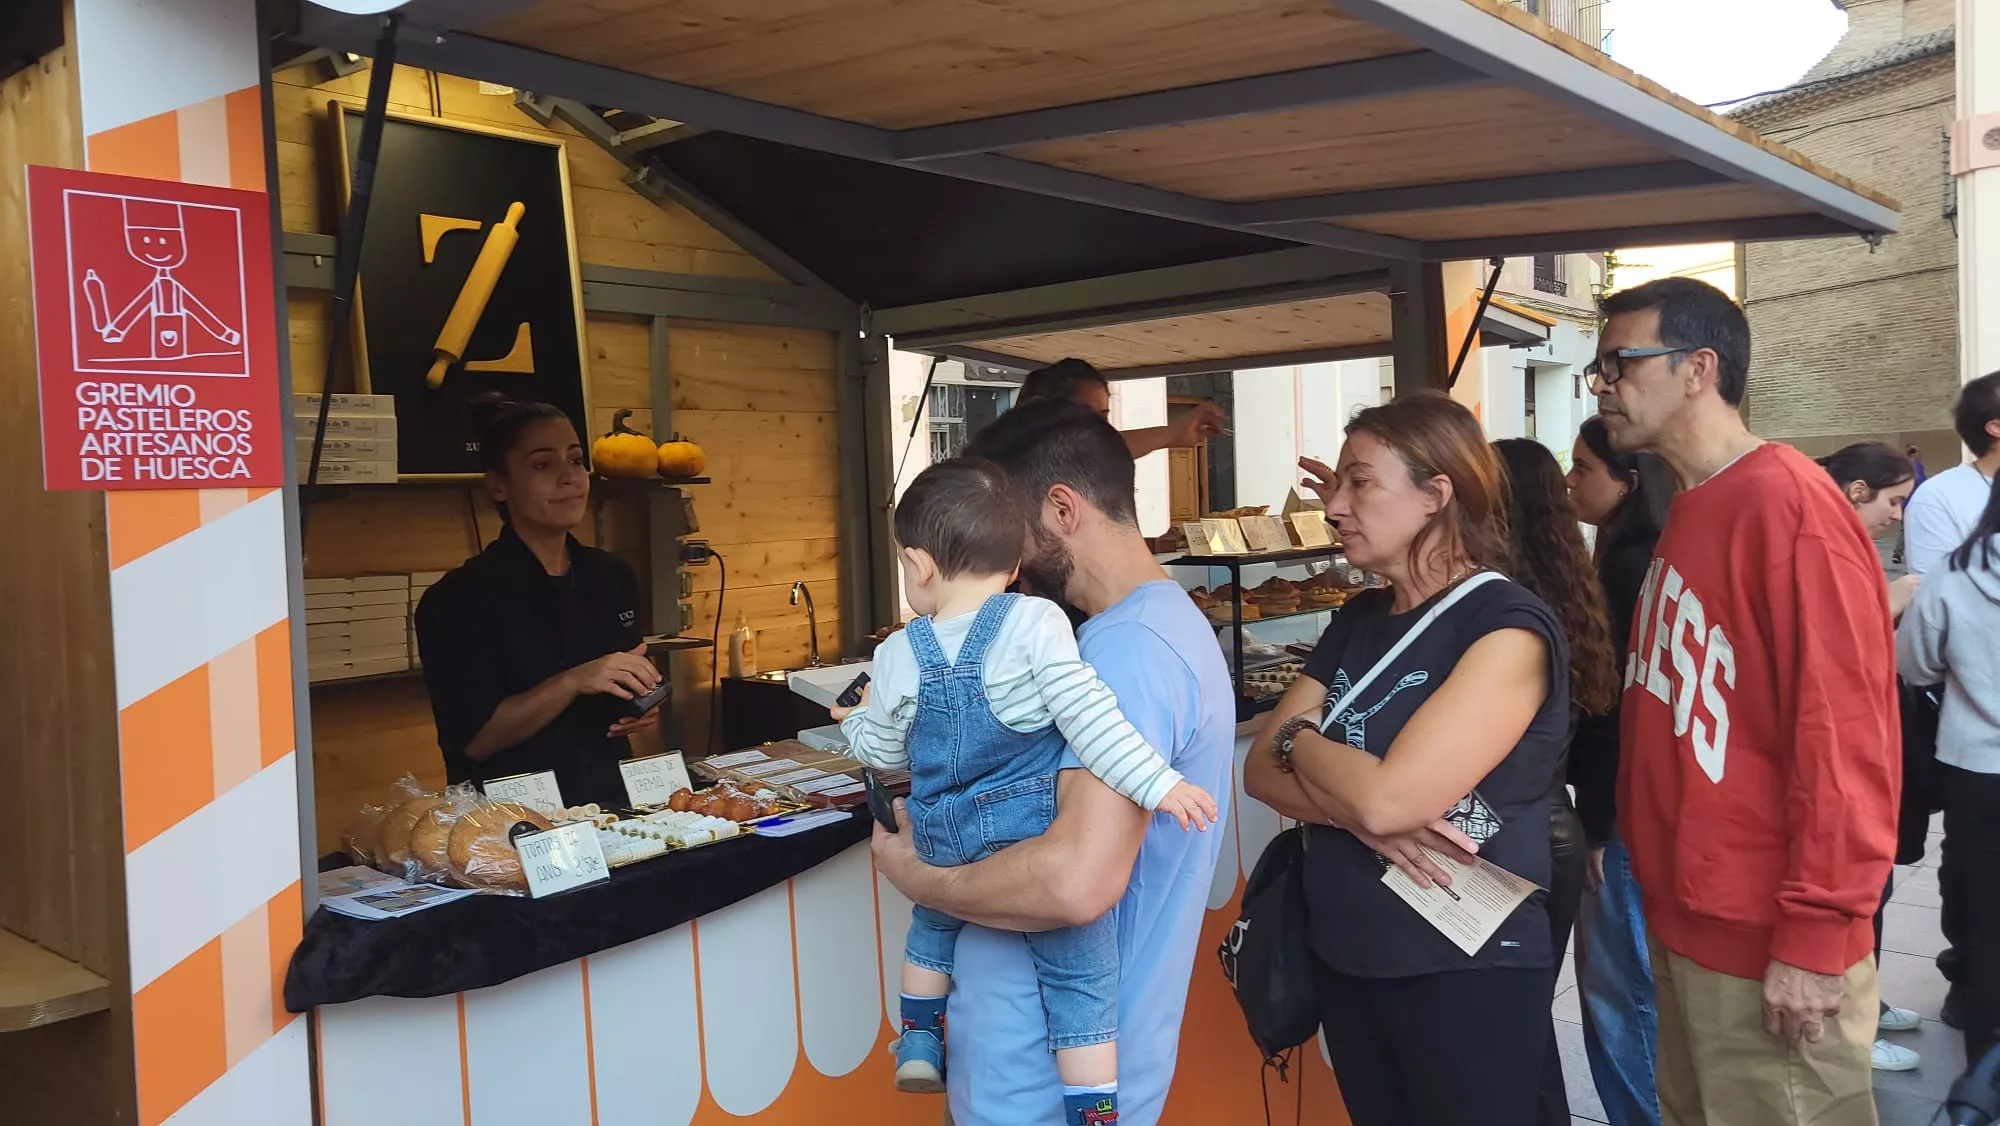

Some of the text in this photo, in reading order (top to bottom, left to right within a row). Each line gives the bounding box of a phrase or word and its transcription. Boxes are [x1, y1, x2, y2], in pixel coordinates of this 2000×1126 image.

[76, 382, 196, 407] GREMIO
[78, 407, 253, 432] PASTELEROS
[79, 432, 253, 456] ARTESANOS
[81, 456, 252, 481] DE HUESCA
